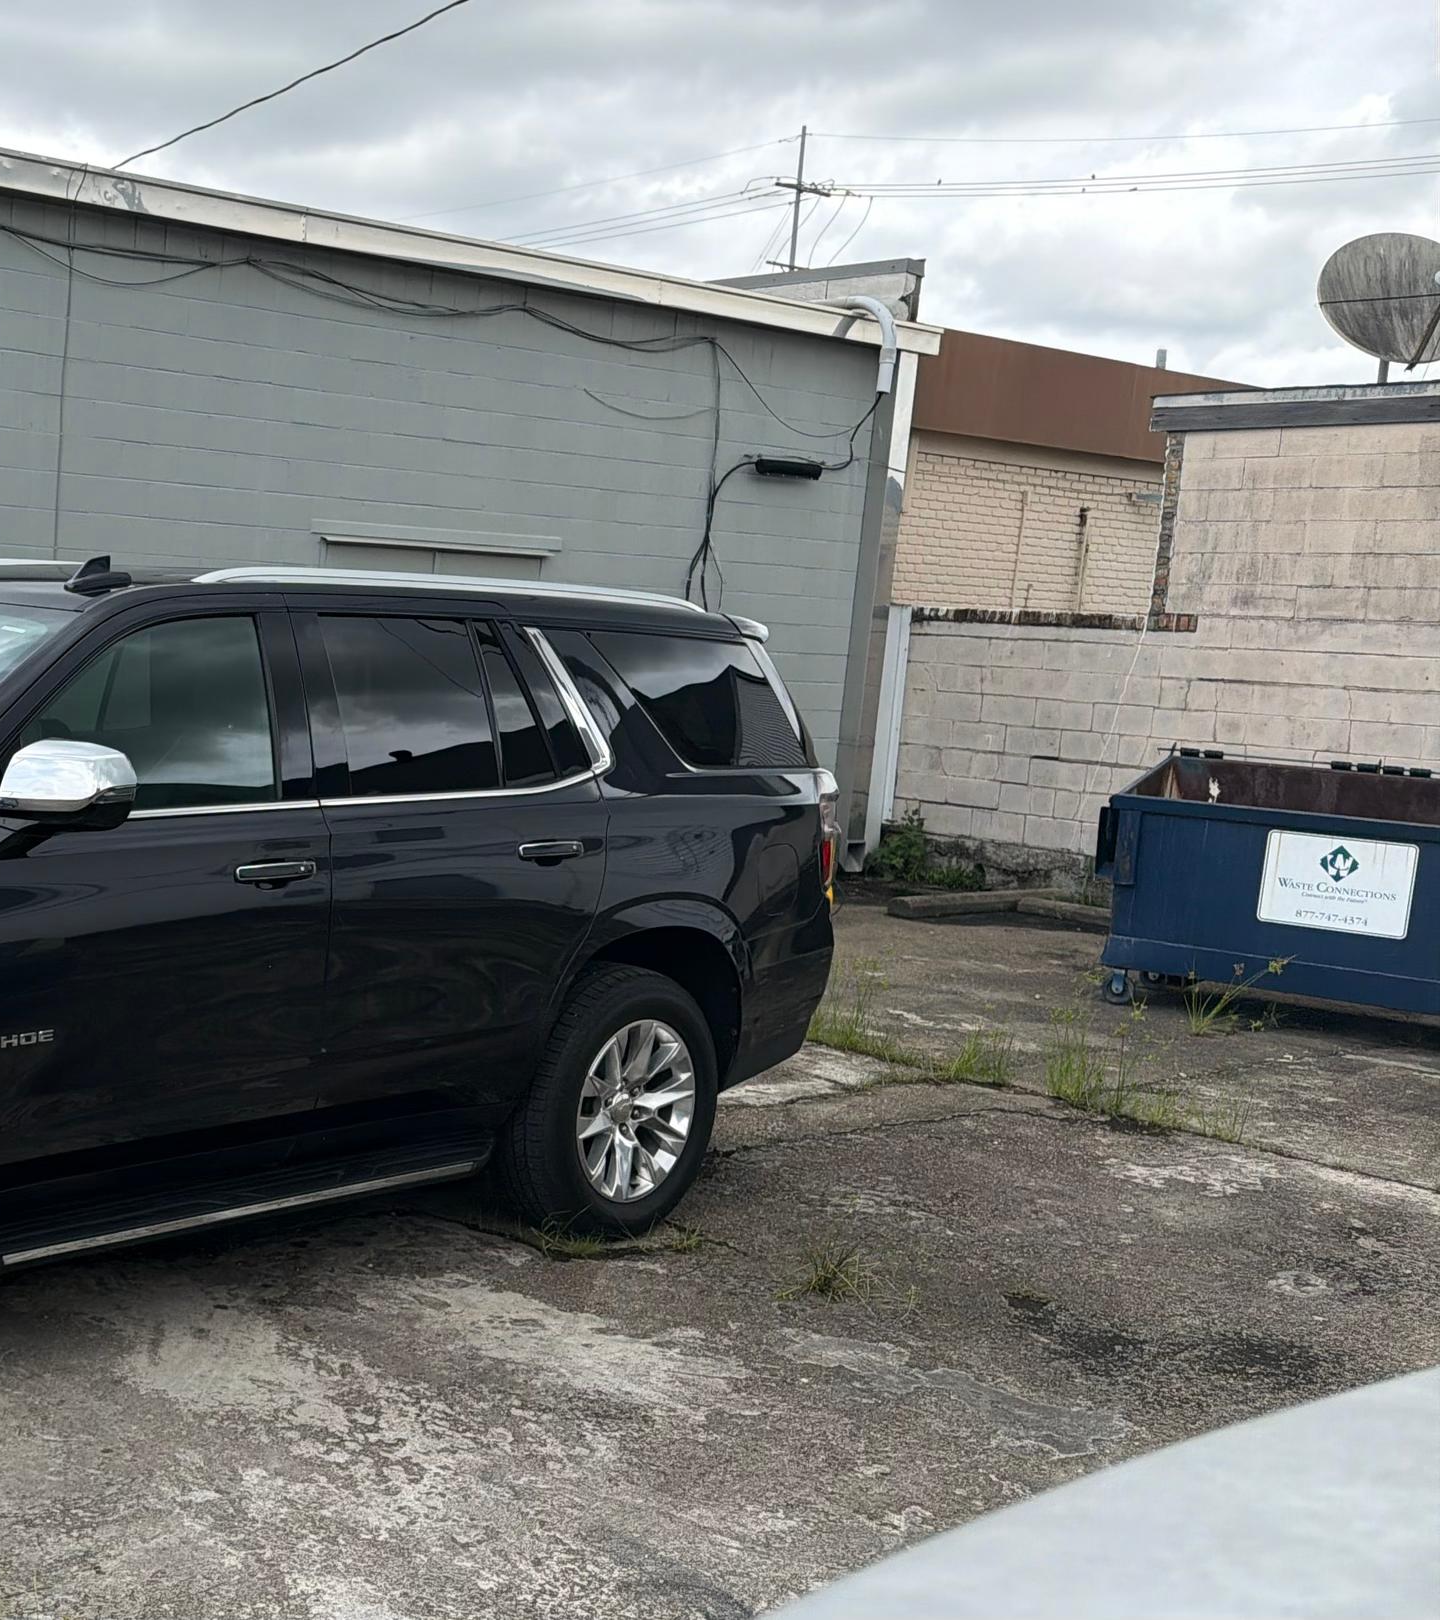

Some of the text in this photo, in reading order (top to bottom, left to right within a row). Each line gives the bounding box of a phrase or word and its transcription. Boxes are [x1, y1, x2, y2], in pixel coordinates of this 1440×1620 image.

[1278, 877, 1397, 901] WASTE CONNECTIONS
[1295, 909, 1368, 926] 877-747-4374
